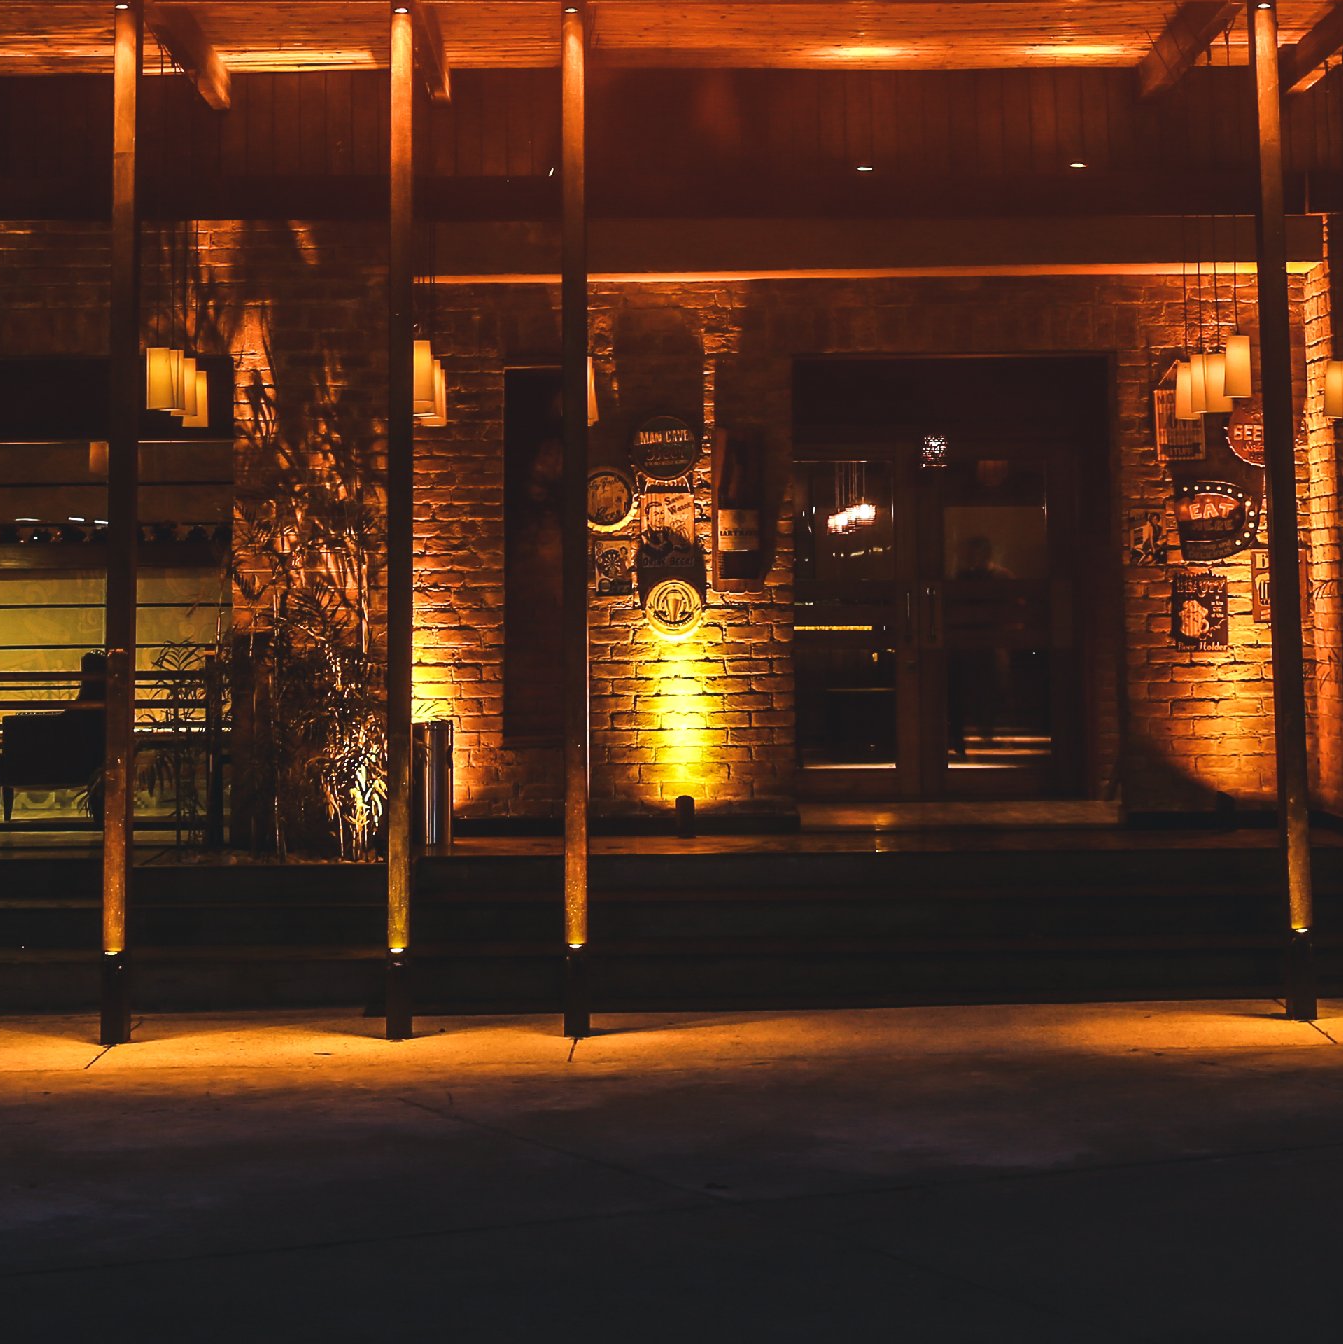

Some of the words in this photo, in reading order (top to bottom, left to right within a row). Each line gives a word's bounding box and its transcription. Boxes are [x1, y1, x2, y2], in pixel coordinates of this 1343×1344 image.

[640, 431, 662, 445] MAN
[665, 429, 689, 443] CAVE
[1234, 424, 1264, 441] BEE
[1189, 503, 1234, 520] EAT
